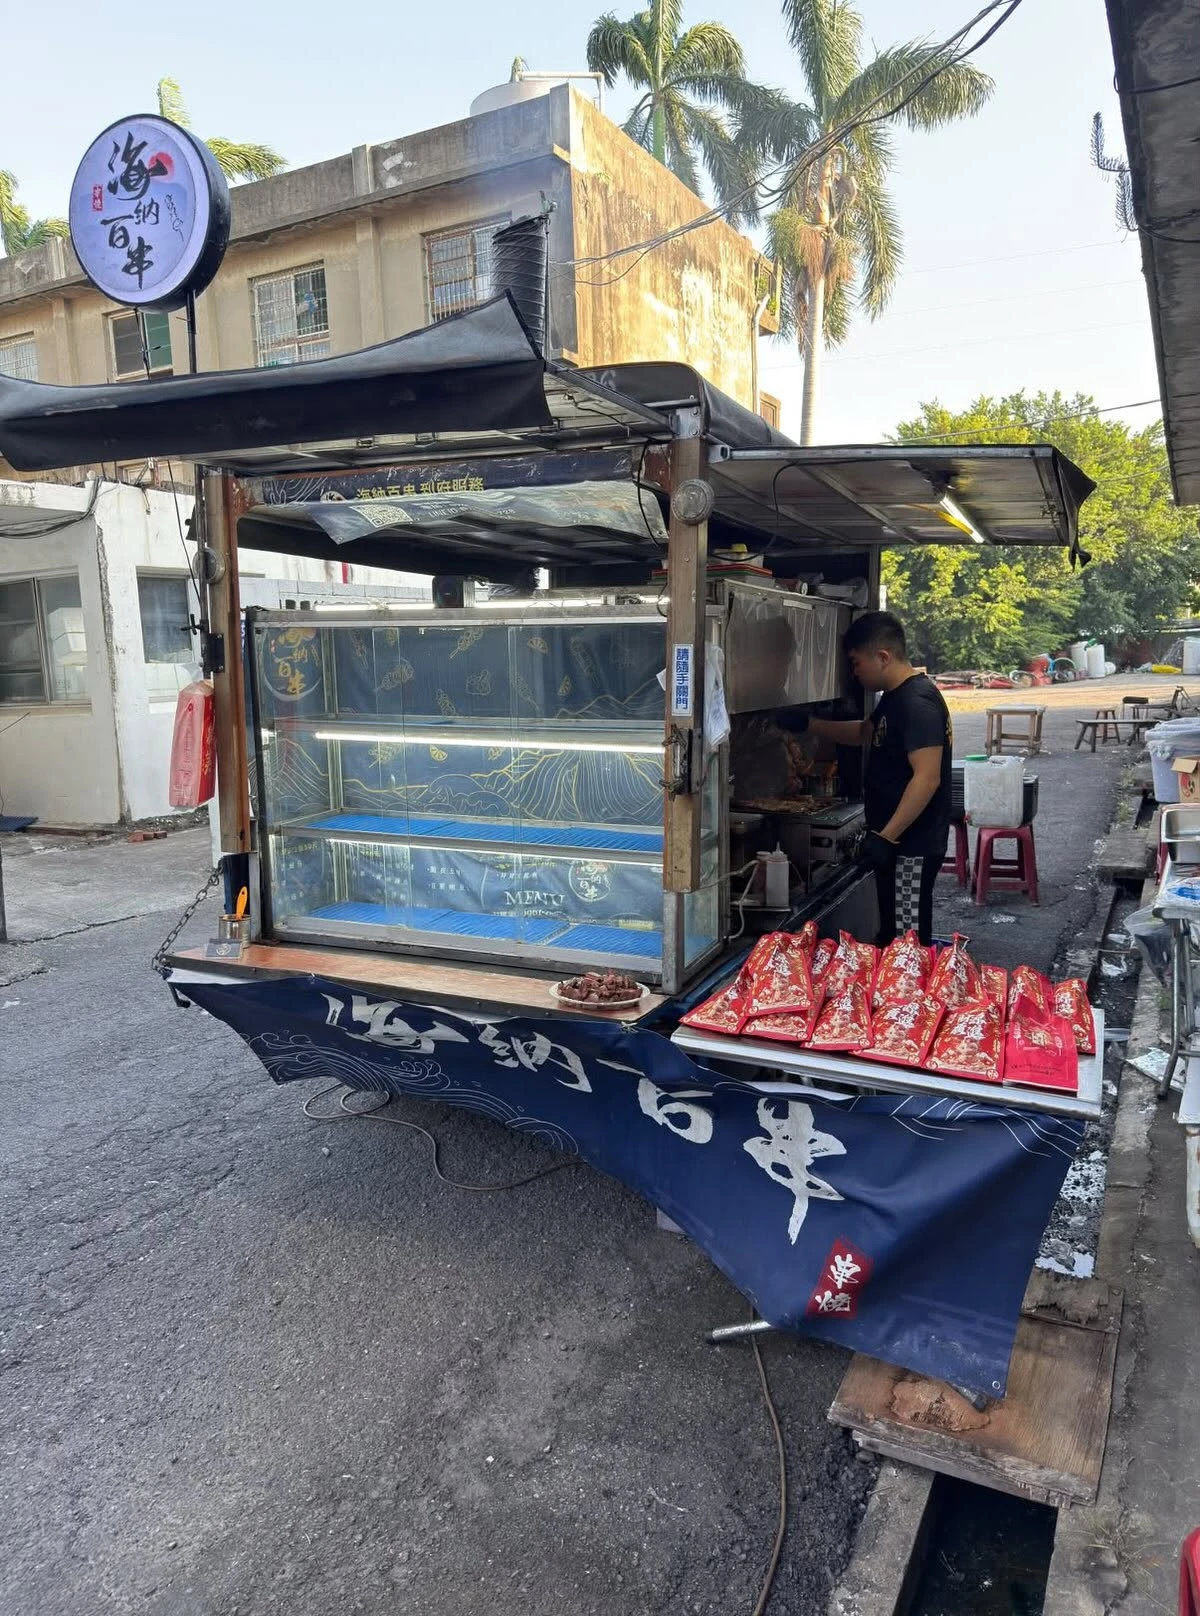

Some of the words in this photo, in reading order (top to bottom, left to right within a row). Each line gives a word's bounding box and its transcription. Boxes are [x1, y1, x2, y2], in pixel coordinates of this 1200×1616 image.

[100, 130, 168, 290] 海納百串
[676, 648, 689, 710] 請隨手關門
[505, 890, 566, 907] MENU
